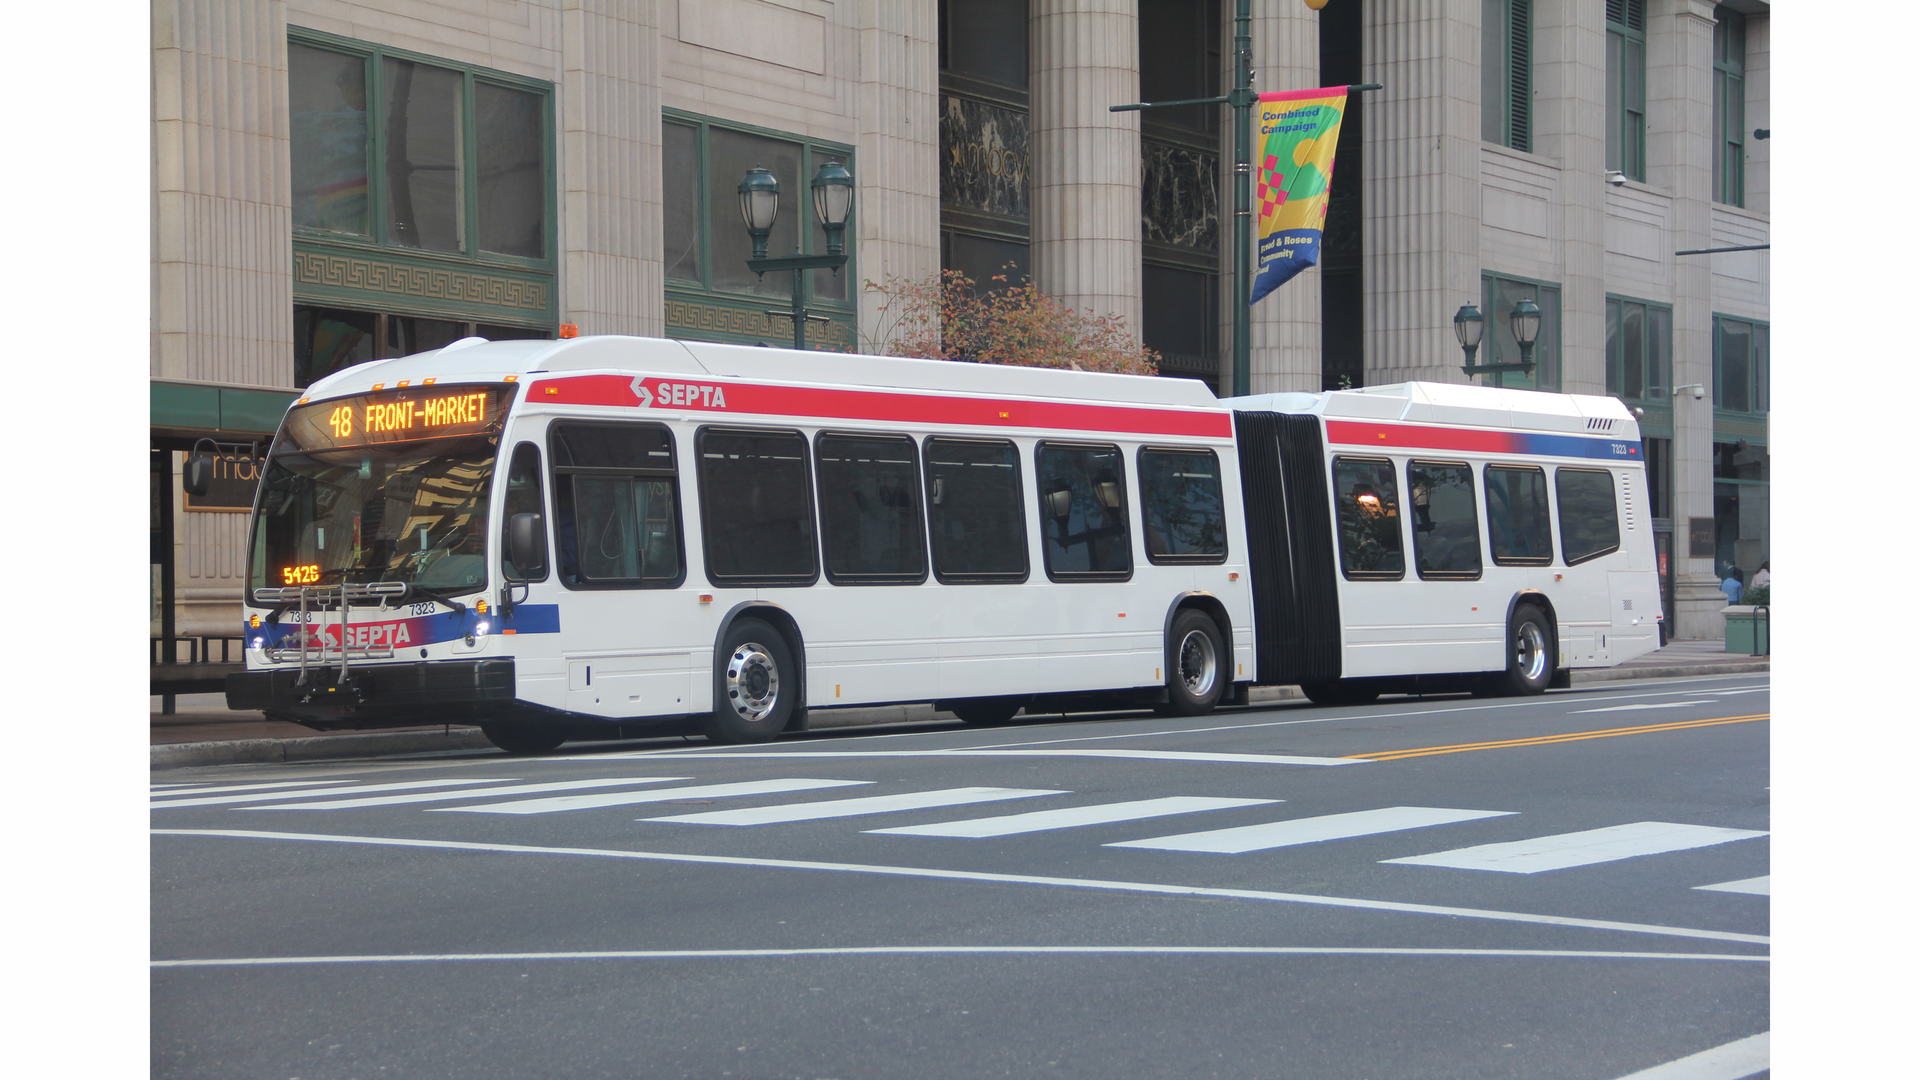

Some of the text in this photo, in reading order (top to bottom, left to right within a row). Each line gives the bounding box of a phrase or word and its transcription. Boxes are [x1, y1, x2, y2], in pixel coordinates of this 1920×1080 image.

[1262, 107, 1320, 121] Combined
[1261, 121, 1317, 135] Campaign
[1276, 237, 1283, 247] &
[1284, 236, 1313, 245] Roses
[657, 382, 727, 408] SEPTA
[329, 393, 487, 438] 48 FRONT-MARKET
[1611, 443, 1627, 455] 7323
[283, 565, 320, 585] 5426
[409, 602, 436, 617] 7323
[290, 611, 312, 623] 733
[346, 622, 411, 647] SEPTA
